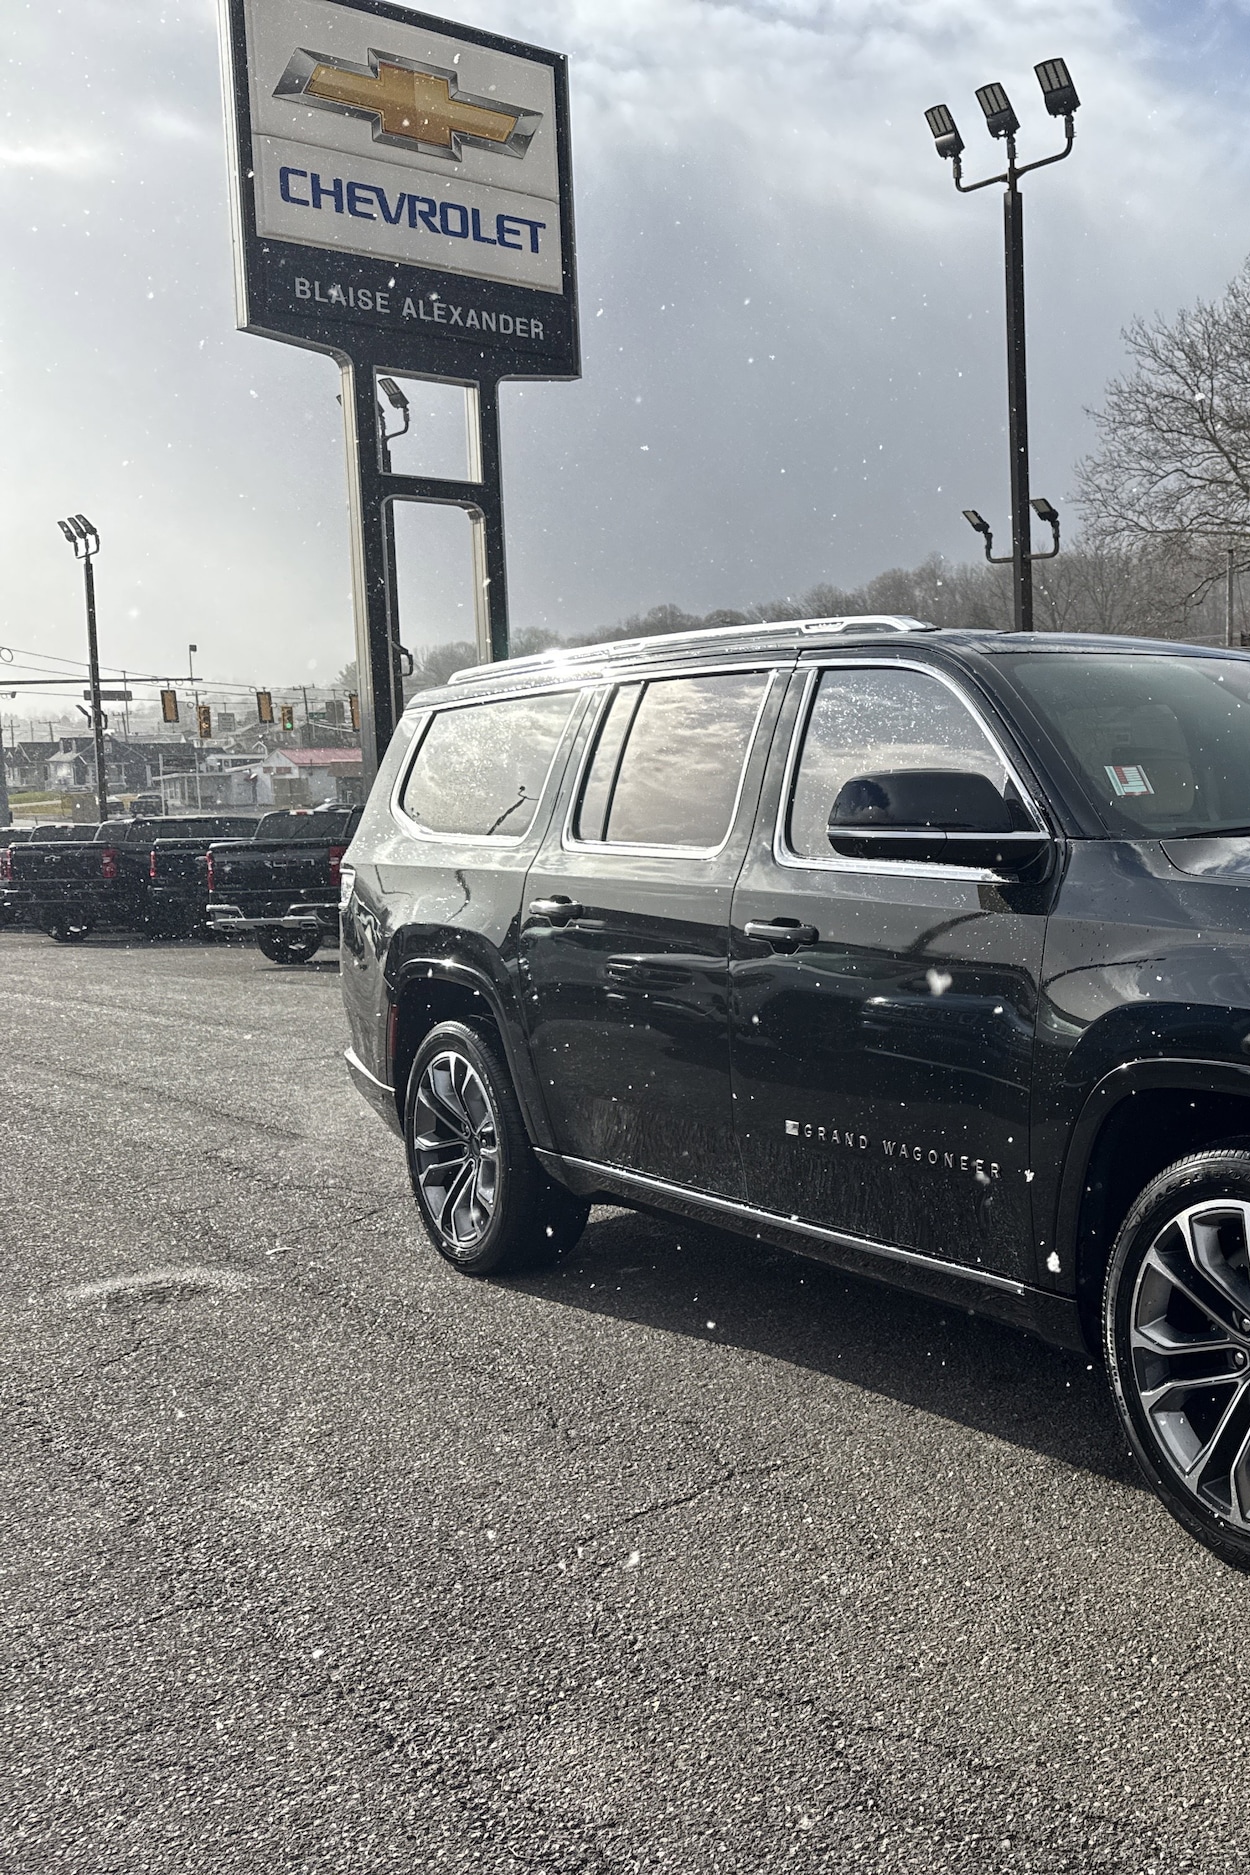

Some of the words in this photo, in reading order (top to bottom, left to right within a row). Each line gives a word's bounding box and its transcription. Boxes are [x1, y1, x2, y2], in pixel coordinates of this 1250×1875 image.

[279, 166, 546, 254] CHEVROLET
[294, 277, 390, 313] BLAISE
[402, 298, 544, 341] ALEXANDER
[804, 1123, 868, 1149] GRAND
[882, 1140, 1000, 1178] WAGONEER
